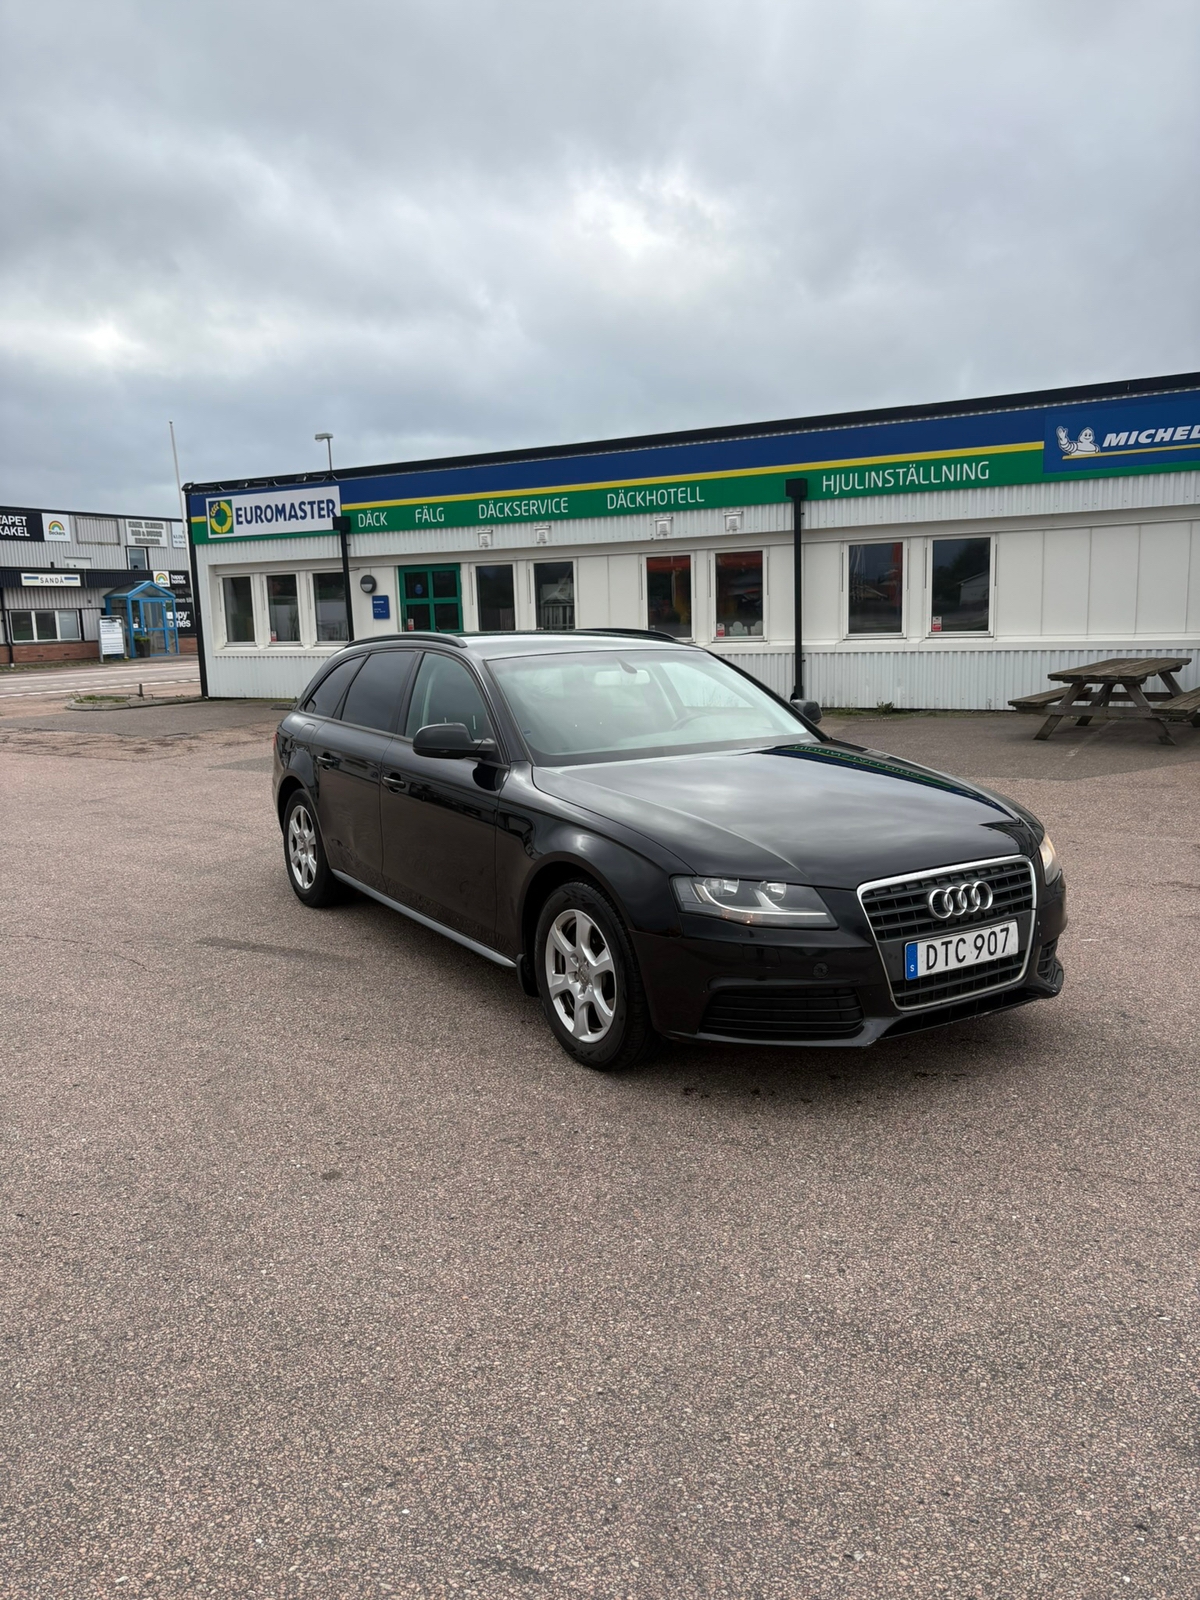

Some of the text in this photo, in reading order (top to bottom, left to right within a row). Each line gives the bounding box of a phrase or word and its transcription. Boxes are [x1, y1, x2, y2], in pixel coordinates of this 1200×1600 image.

[1102, 424, 1200, 448] MICHEL
[358, 460, 990, 528] DÄCK FÄLG DÄCKSERVICE DÄCKHOTELL HJULINSTÄLLNING
[235, 498, 337, 526] EUROMASTER
[926, 928, 1009, 971] DTC 907
